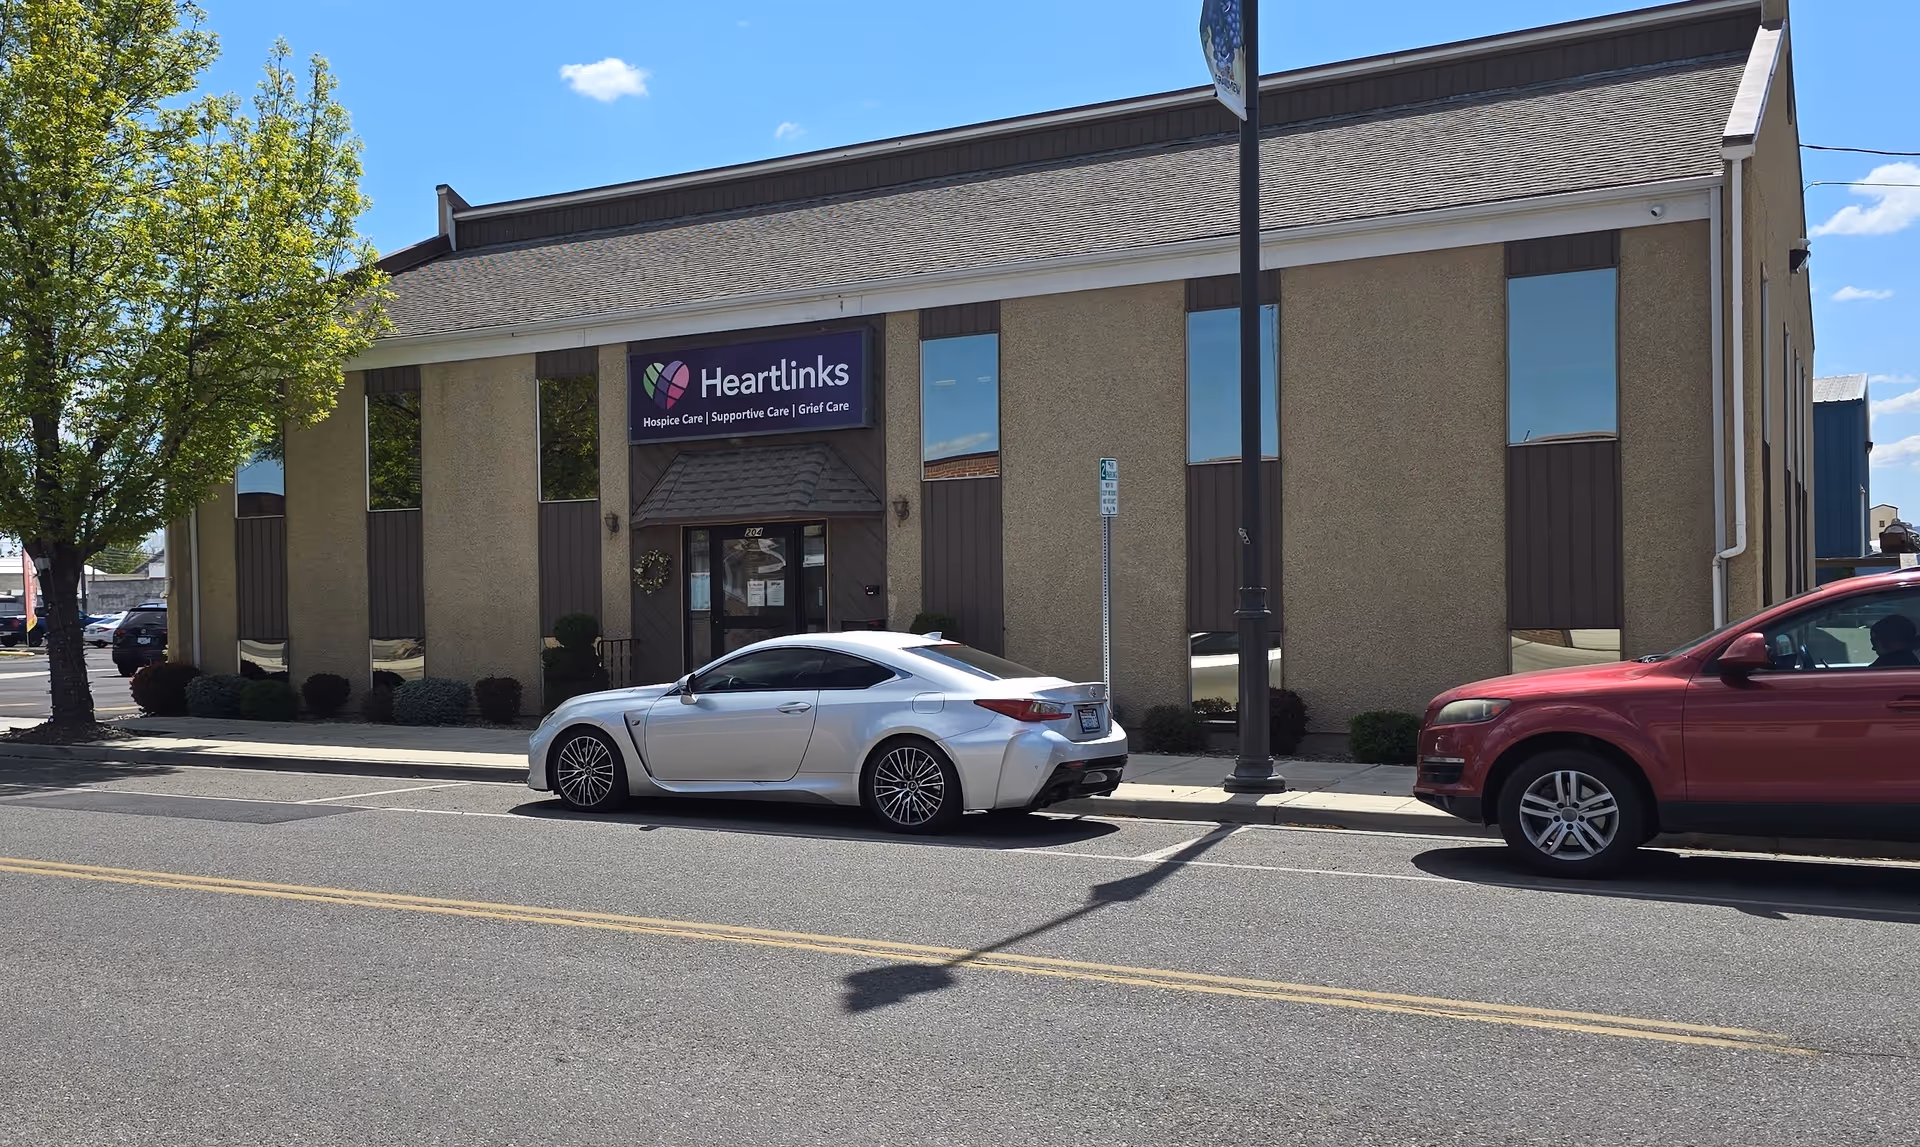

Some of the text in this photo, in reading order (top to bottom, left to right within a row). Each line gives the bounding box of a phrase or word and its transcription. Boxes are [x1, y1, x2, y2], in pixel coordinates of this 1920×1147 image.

[701, 355, 849, 398] Heartlinks
[643, 415, 680, 429] Hospice
[682, 413, 703, 425] Care
[711, 408, 764, 424] Supportive
[767, 406, 790, 418] Care
[798, 401, 824, 415] Grief
[826, 401, 849, 412] Care
[1101, 462, 1106, 477] 2
[746, 528, 763, 537] 204
